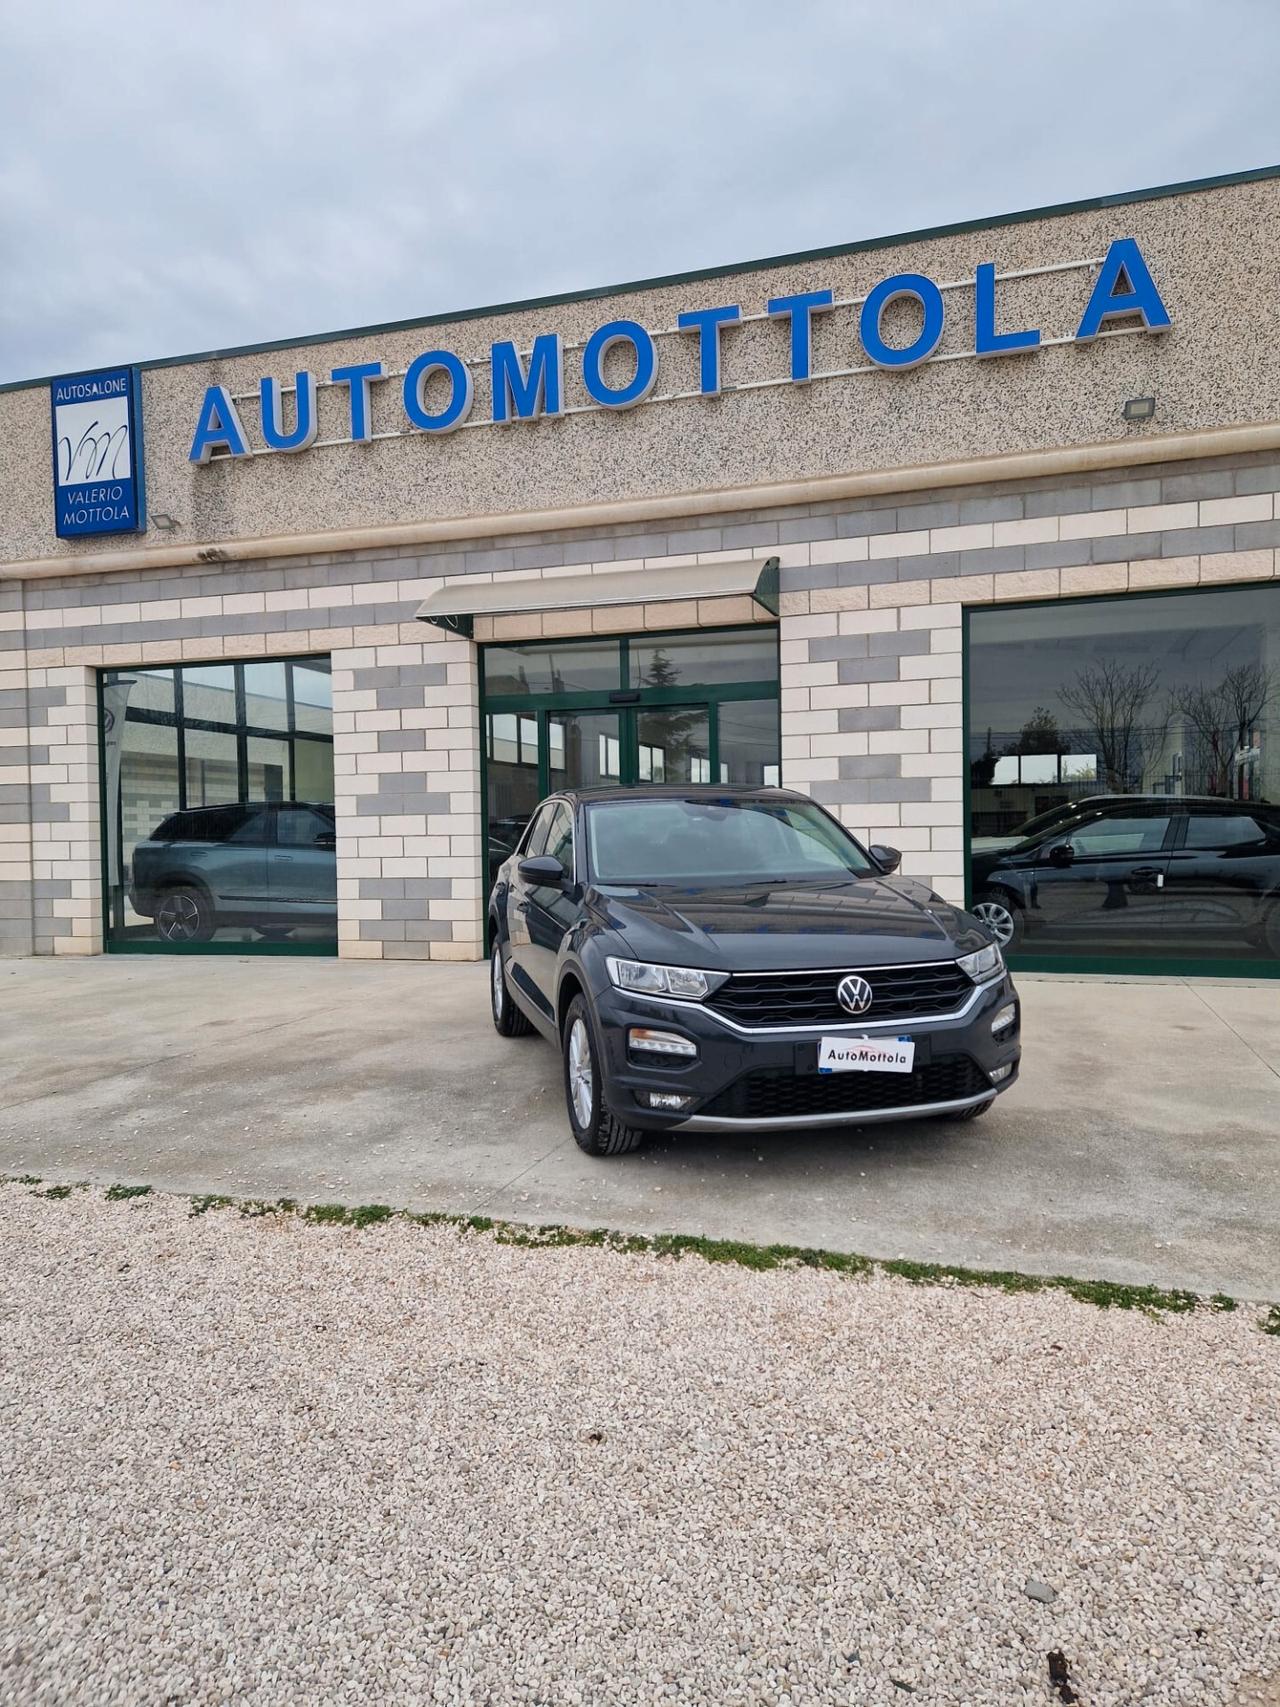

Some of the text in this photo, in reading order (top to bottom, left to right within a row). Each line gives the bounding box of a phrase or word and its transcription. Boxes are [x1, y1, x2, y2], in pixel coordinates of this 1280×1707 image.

[188, 237, 1172, 465] AUTOMOTTOLA
[56, 378, 127, 400] AUTOSALONE
[67, 486, 123, 505] VALERIO
[63, 505, 130, 525] MOTTOLA
[827, 1049, 906, 1064] AutoMottola
